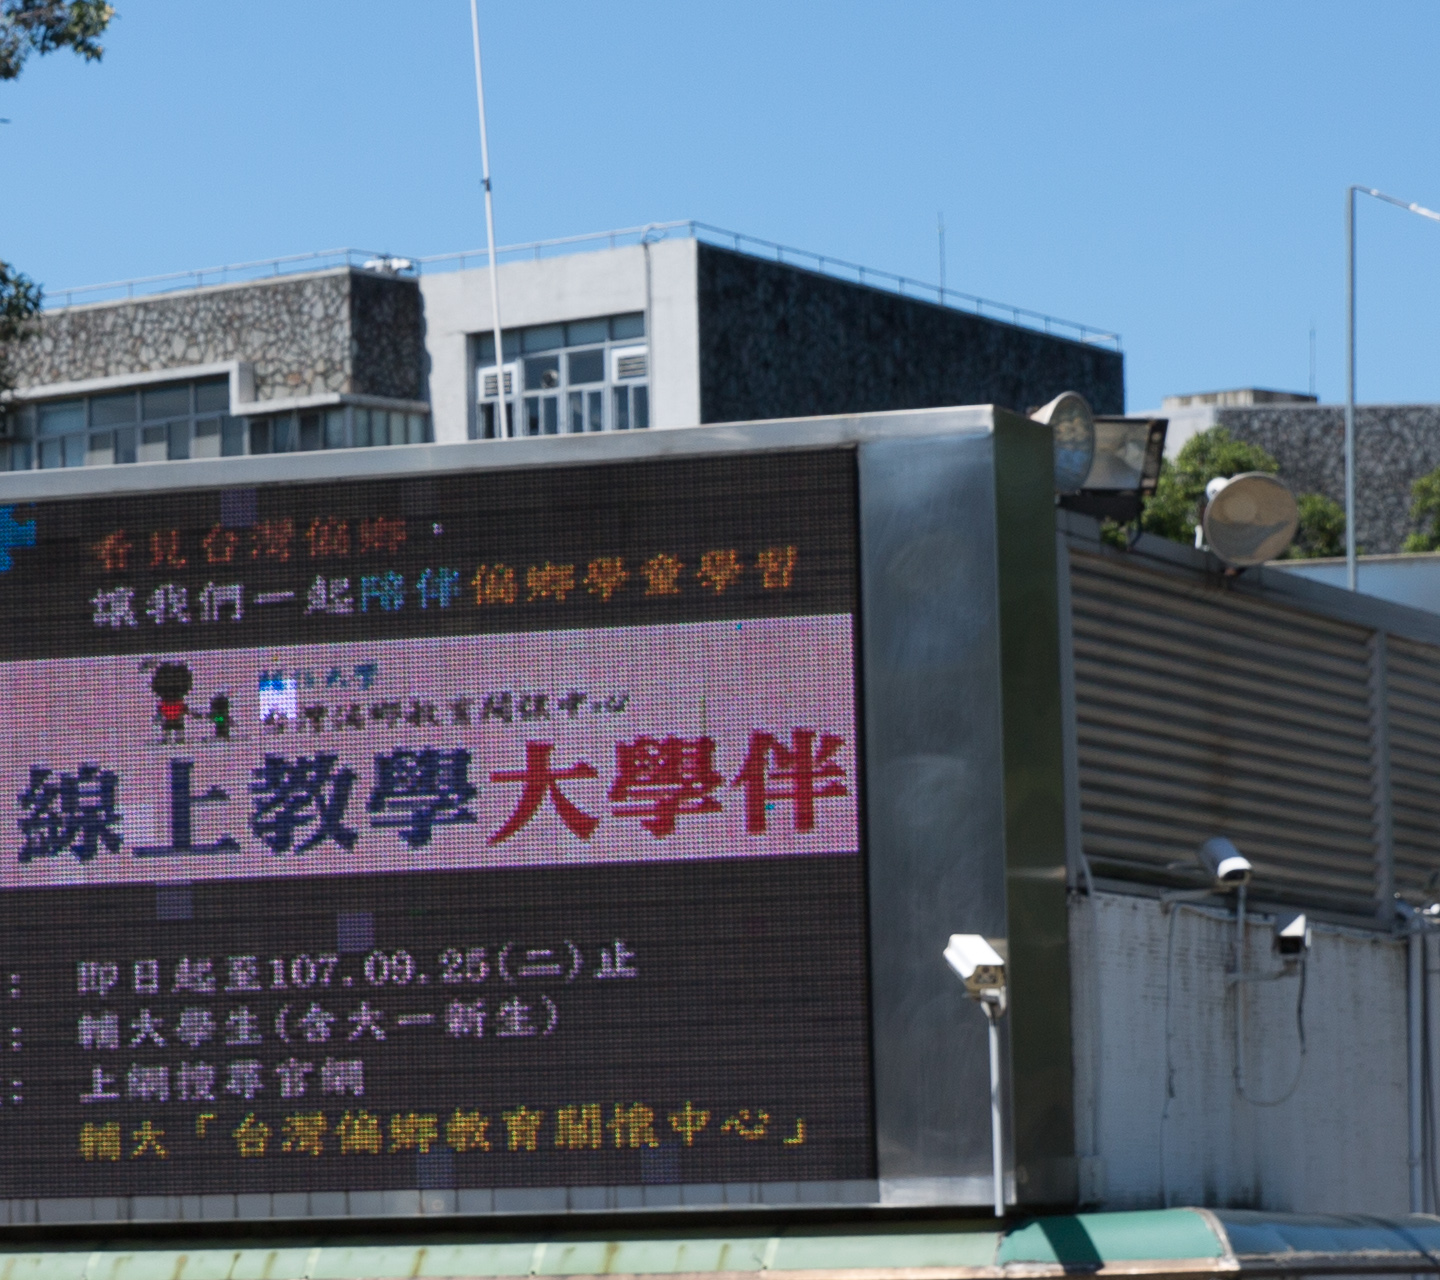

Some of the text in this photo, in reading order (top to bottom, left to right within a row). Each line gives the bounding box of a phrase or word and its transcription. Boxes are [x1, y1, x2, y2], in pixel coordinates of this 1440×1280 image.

[18, 726, 850, 865] 線上教學大學伴
